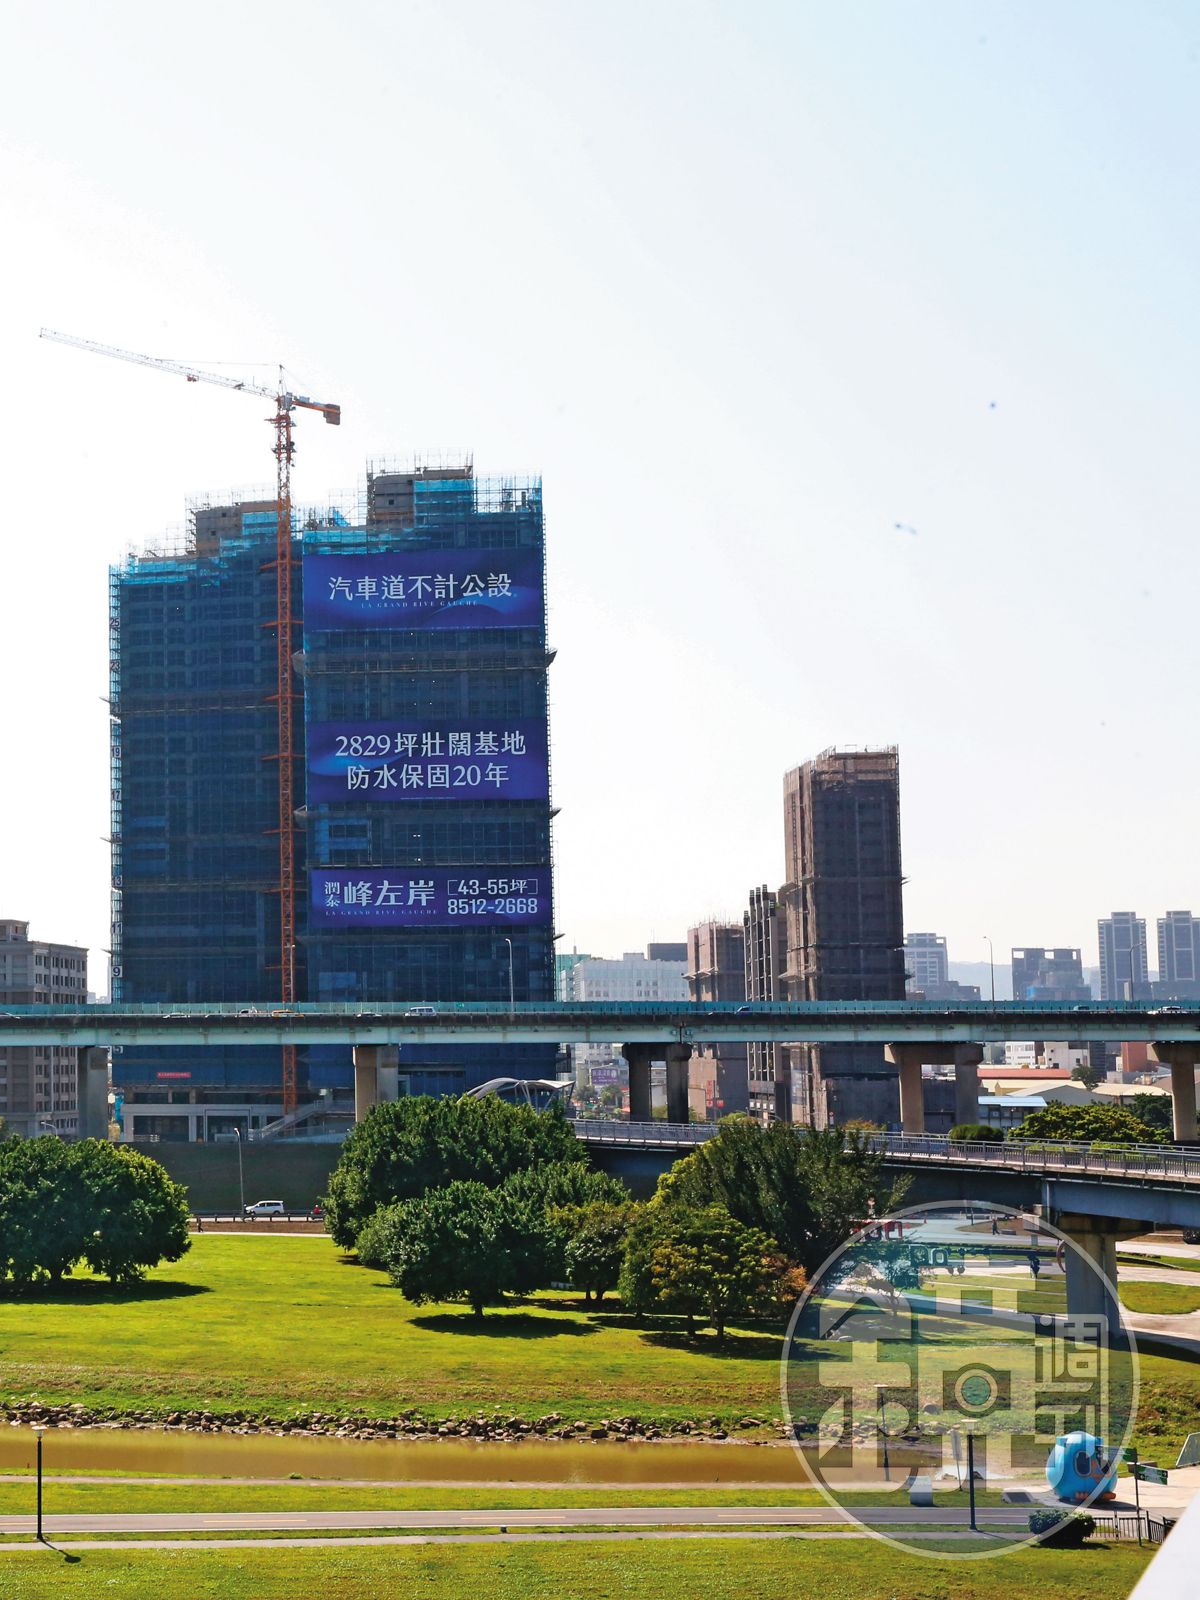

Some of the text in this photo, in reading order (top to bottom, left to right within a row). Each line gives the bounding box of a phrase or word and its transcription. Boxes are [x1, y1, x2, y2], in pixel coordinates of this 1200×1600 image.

[328, 573, 512, 601] 汽車道不計公設
[110, 617, 120, 627] 25
[112, 747, 121, 757] 19
[335, 731, 526, 758] 2829坪壯闊基地
[347, 762, 509, 789] 防水保固20年
[112, 790, 121, 800] 17
[113, 877, 121, 886] 13
[457, 878, 528, 895] 43-55坪
[324, 881, 340, 907] 潤泰
[343, 880, 435, 906] 峰左岸
[448, 898, 538, 915] 8512-2668
[112, 924, 121, 933] 11
[112, 967, 121, 977] 9
